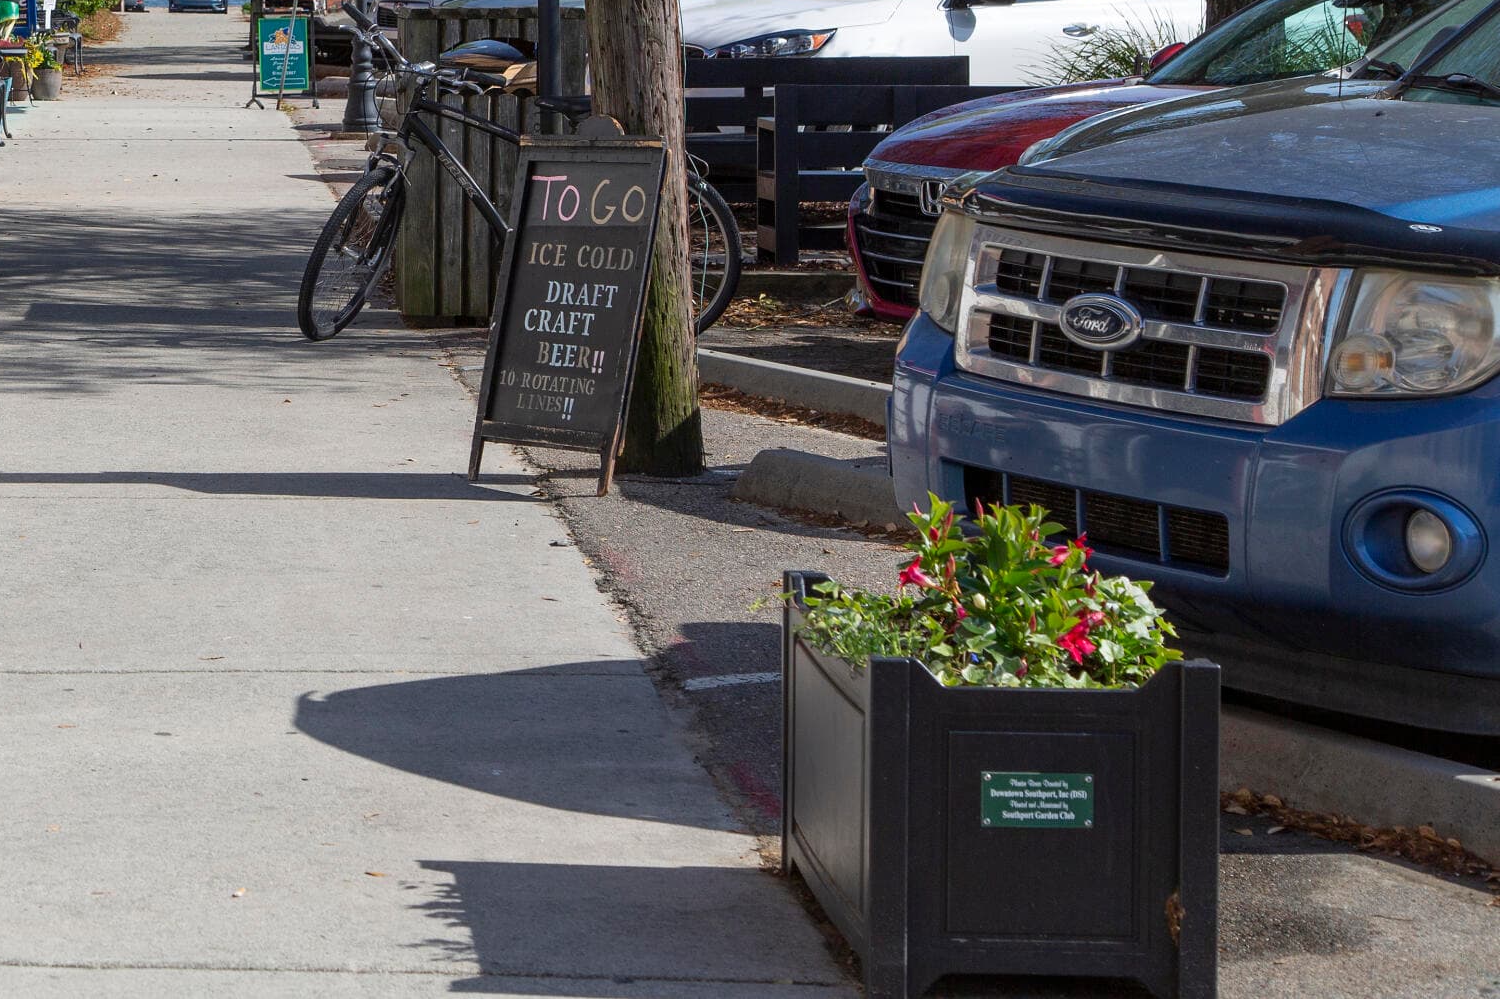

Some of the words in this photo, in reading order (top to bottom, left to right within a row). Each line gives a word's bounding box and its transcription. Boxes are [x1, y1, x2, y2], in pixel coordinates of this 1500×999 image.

[531, 175, 580, 222] TO
[590, 178, 646, 225] GO
[528, 241, 567, 267] ICE
[577, 244, 634, 272] COLD
[545, 280, 619, 309] DRAFT
[524, 308, 596, 337] CRAFT
[1073, 306, 1112, 333] Ford
[538, 341, 605, 374] BEER!!
[500, 369, 516, 387] 10
[521, 371, 596, 396] ROTATING
[516, 393, 575, 421] LINES!!
[990, 788, 1024, 798] Downtown
[1024, 789, 1058, 800] Southport,
[1058, 789, 1069, 799] Inc
[1070, 790, 1087, 800] (DSI)
[1002, 810, 1034, 820] Southport
[1034, 810, 1059, 820] Garden
[1059, 810, 1075, 820] Club
